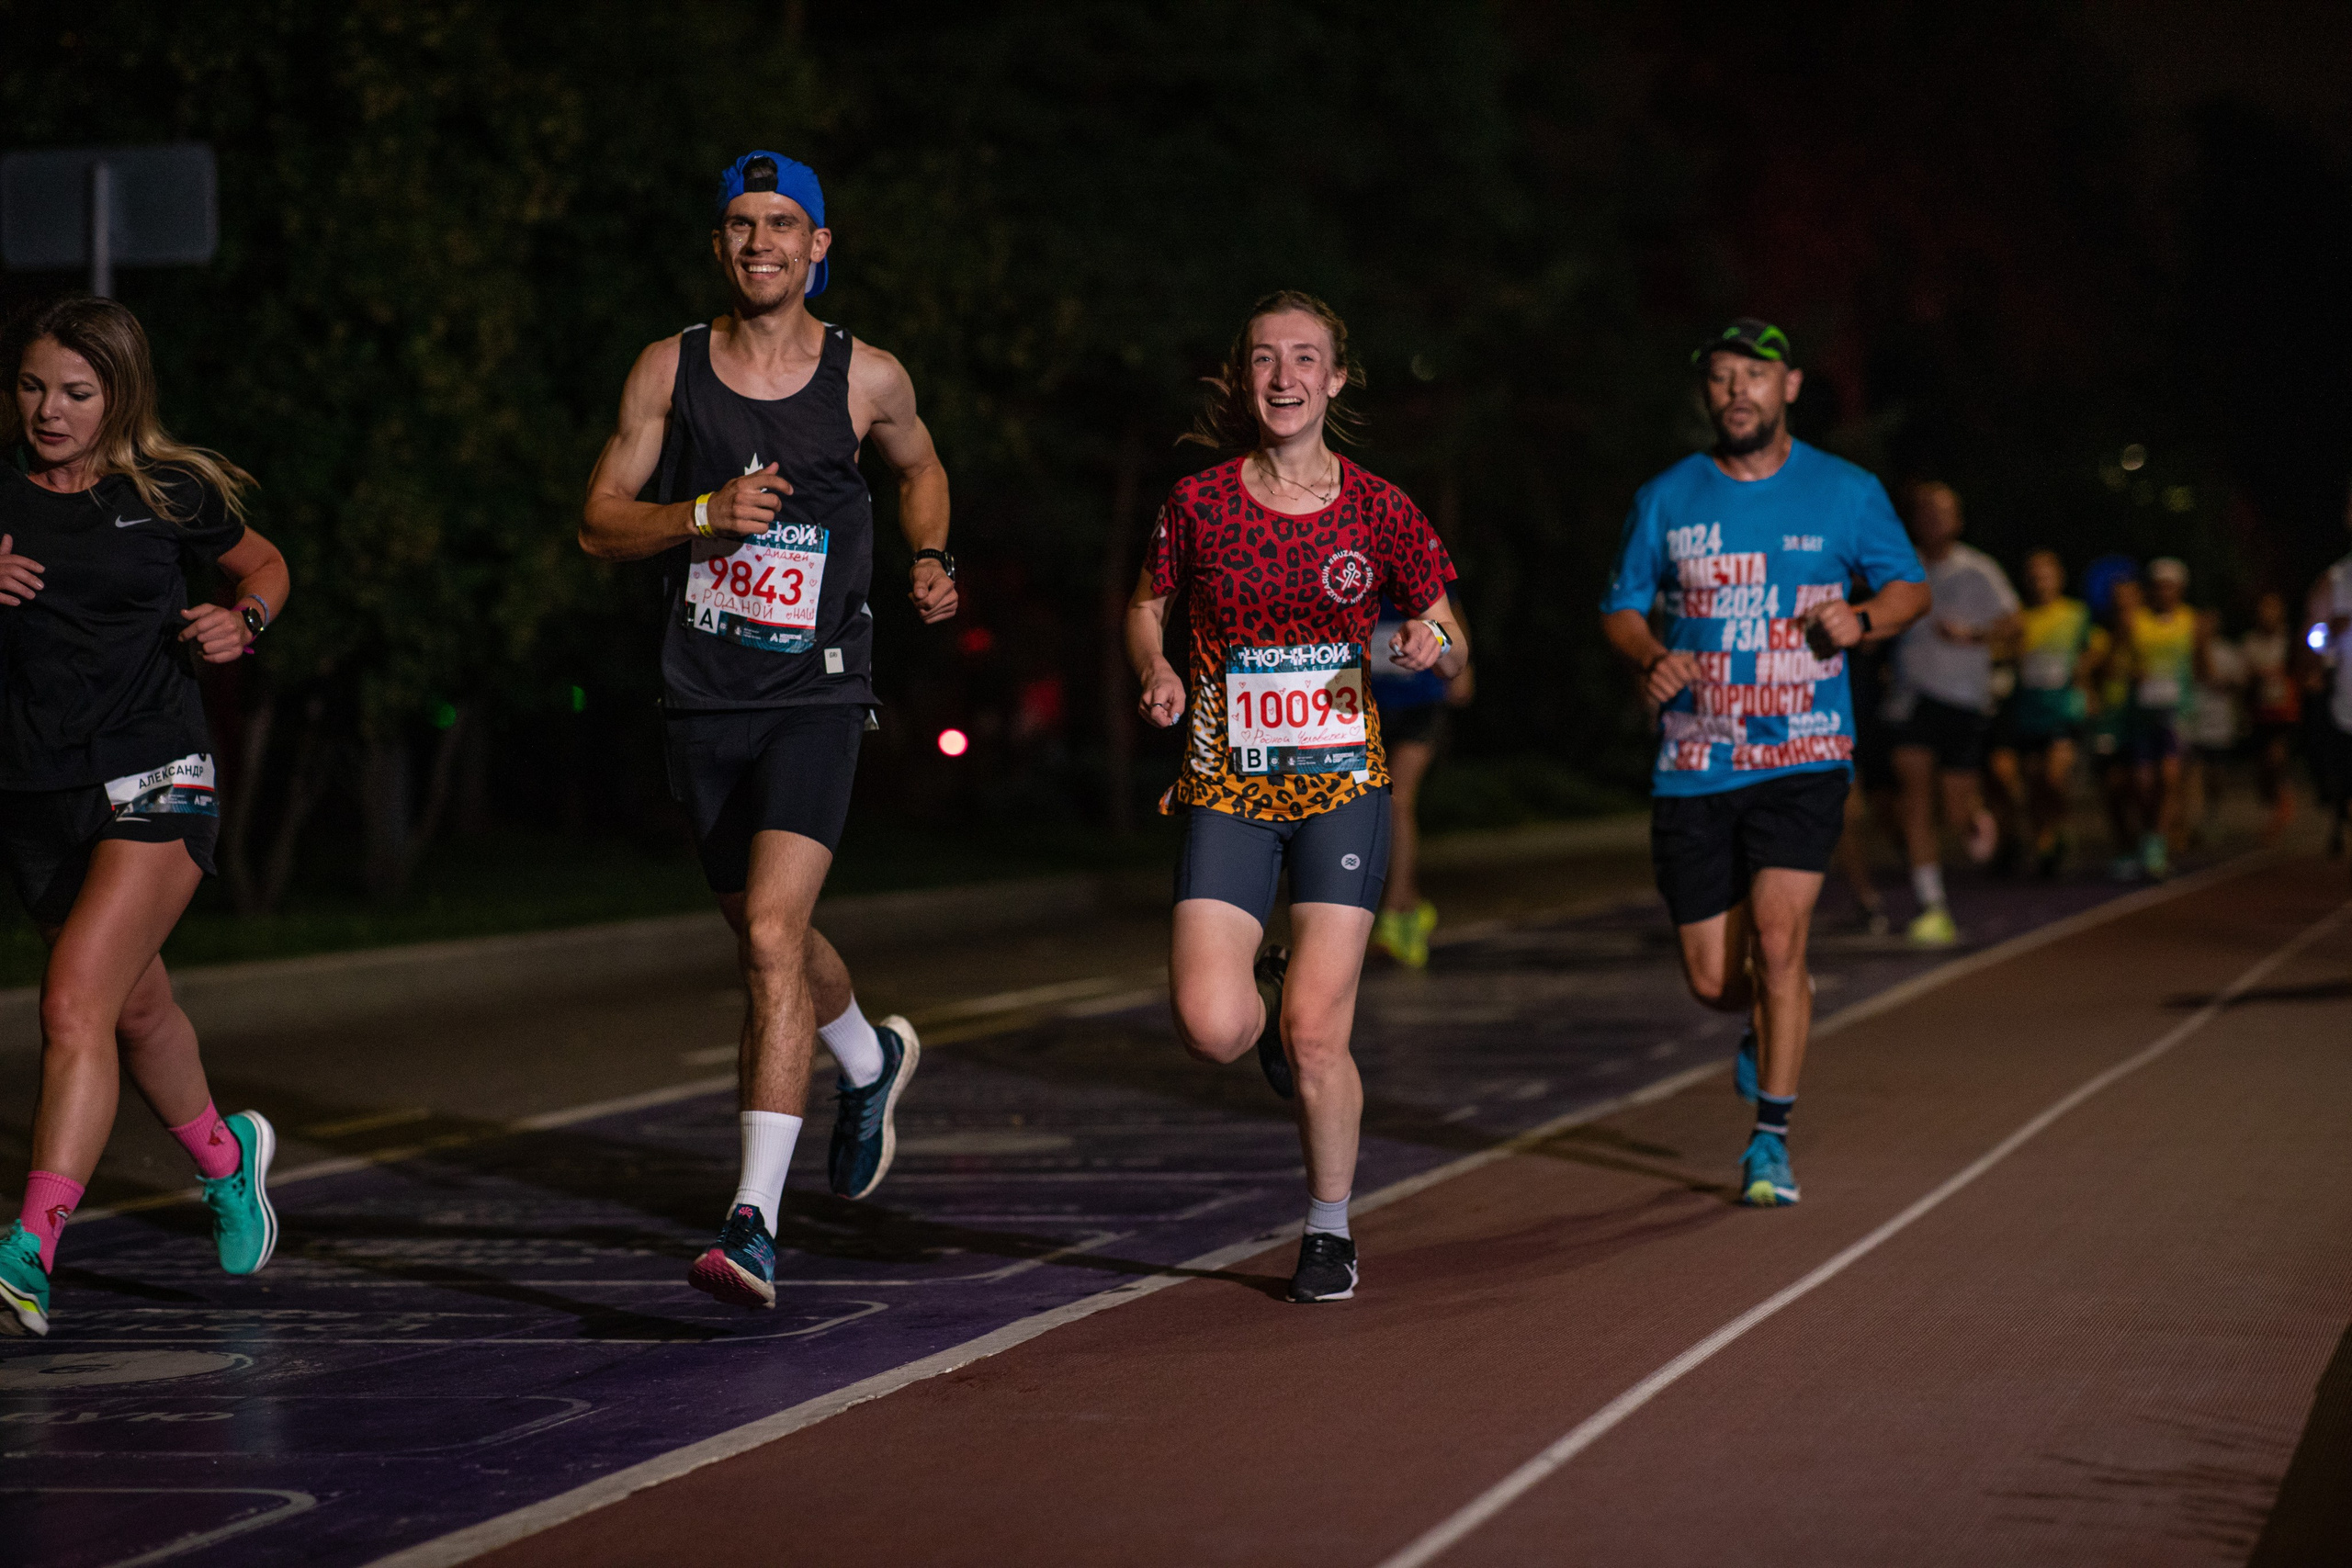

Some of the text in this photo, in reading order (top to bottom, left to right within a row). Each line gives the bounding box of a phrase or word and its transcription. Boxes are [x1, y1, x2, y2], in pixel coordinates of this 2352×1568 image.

[708, 555, 804, 605] 9843
[702, 589, 774, 620] РОДНОЙ
[793, 607, 815, 621] НАШ
[1238, 642, 1351, 668] НОЧНОЙ
[1237, 686, 1359, 728] 10093
[139, 764, 204, 790] АЛЕКСАНДР
